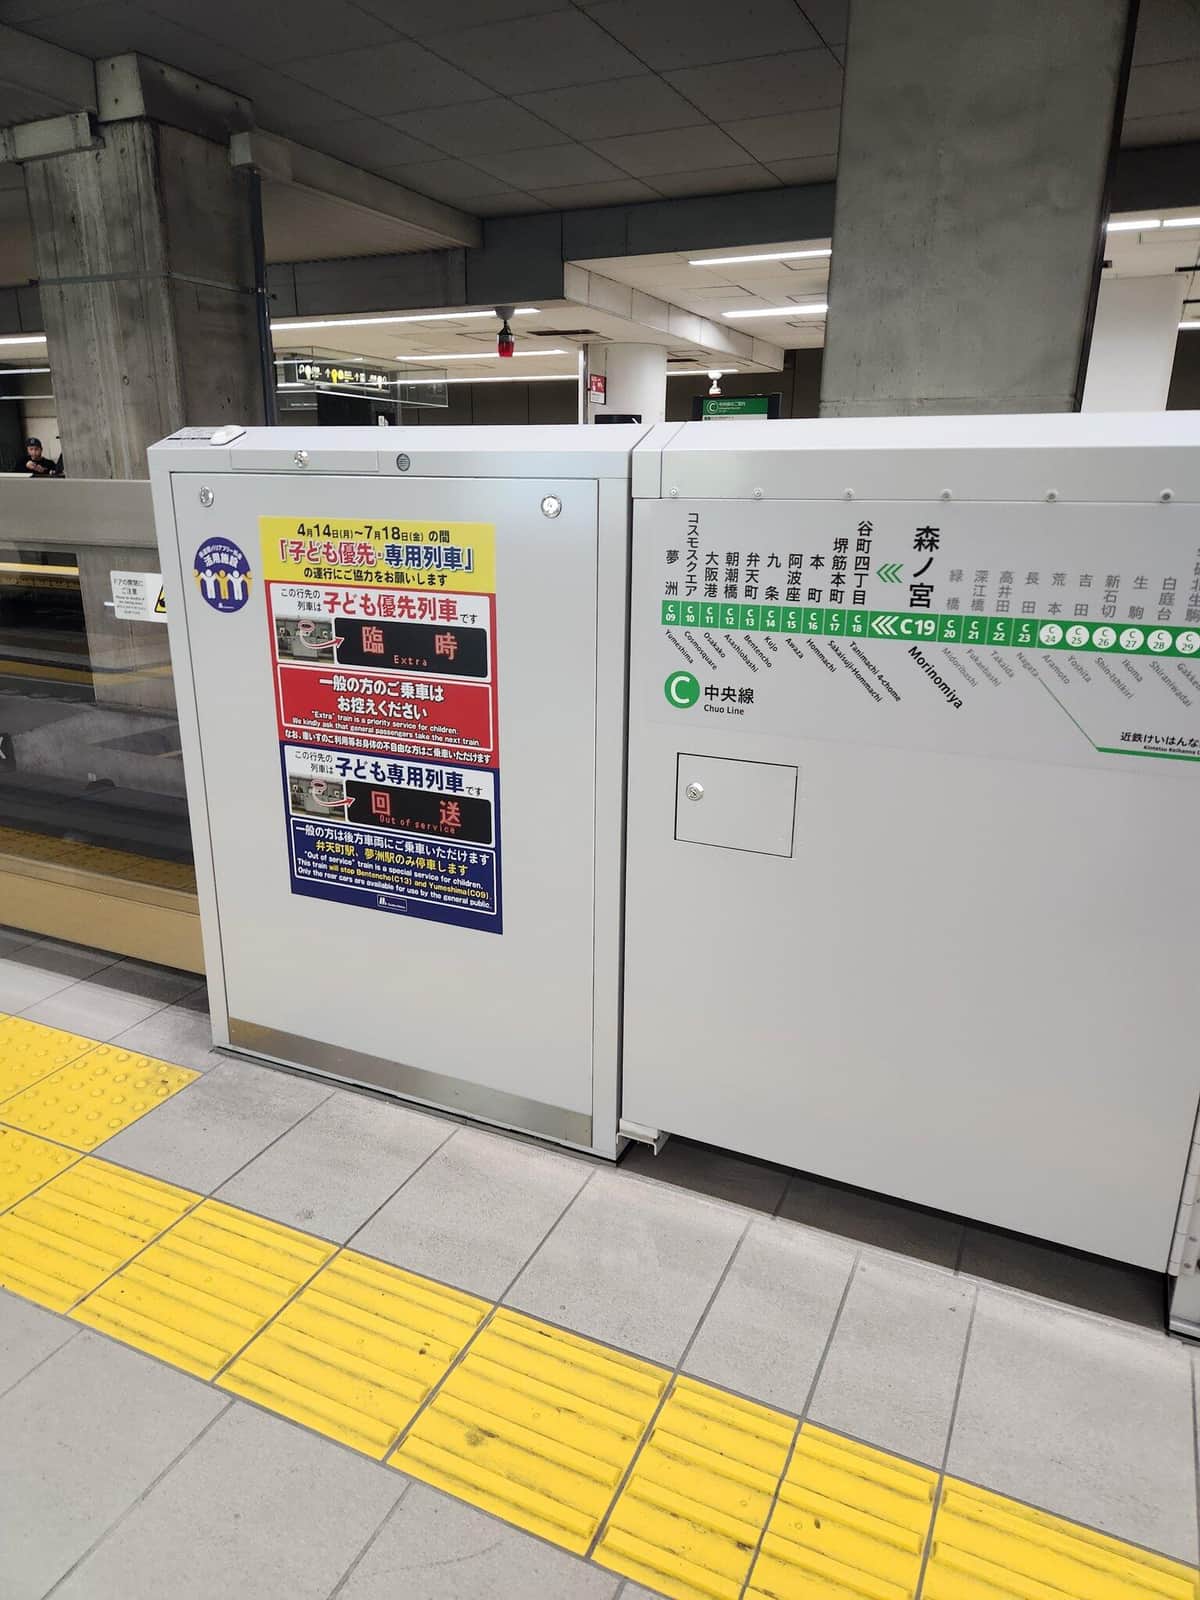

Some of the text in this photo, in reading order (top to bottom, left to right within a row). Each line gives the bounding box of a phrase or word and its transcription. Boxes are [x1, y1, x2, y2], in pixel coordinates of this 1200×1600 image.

[429, 530, 450, 543] の間
[685, 512, 699, 597] コスモスクエア
[853, 521, 873, 605] 谷町四丁目
[910, 526, 940, 609] 森ノ宮
[304, 568, 448, 586] の運行にご協力をお願いします
[665, 550, 679, 596] 夢洲
[704, 552, 719, 598] 大阪港
[724, 552, 739, 599] 朝潮橋
[744, 553, 761, 600] 弁天町
[765, 553, 782, 601] 九条
[786, 554, 803, 602] 阿波座
[808, 555, 825, 602] 本町
[829, 538, 849, 604] 堺筋本町
[281, 589, 321, 600] この行先の
[971, 570, 989, 613] 深江橋
[996, 571, 1015, 613] 高井田
[1022, 572, 1040, 615] 長田
[1048, 573, 1067, 615] 荒本
[1074, 575, 1093, 617] 吉田
[1102, 575, 1121, 618] 新石切
[1128, 577, 1149, 620] 生駒
[1157, 577, 1177, 621] 白庭台
[297, 601, 322, 613] 列車は
[666, 605, 676, 622] C 09
[686, 606, 695, 623] C 10
[705, 607, 714, 624] C 11
[725, 608, 735, 625] C 12
[745, 609, 755, 626] C 13
[766, 610, 776, 628] C 14
[787, 612, 796, 629] C 15
[808, 613, 818, 630] C 16
[830, 614, 840, 631] C 17
[852, 615, 862, 633] C 18
[900, 619, 936, 636] C19
[944, 620, 956, 639] C 20
[968, 621, 980, 640] C 21
[993, 622, 1005, 641] C 22
[1018, 624, 1031, 643] C 23
[1049, 626, 1055, 635] C
[665, 629, 695, 665] Yumeshima
[703, 632, 726, 659] Osakako
[764, 636, 779, 653] Kujo
[785, 637, 805, 660] Awaza
[1072, 628, 1083, 645] C 25
[1098, 629, 1110, 647] C 26
[1126, 631, 1138, 648] C 27
[1153, 632, 1165, 650] C 28
[1182, 633, 1194, 652] C 29
[393, 655, 428, 667] Extra
[684, 631, 718, 671] Cosmosquare
[724, 634, 760, 674] Asashiobashi
[744, 635, 773, 668] Bentencho
[806, 639, 837, 674] Hommachi
[827, 640, 882, 703] Sakaisuji-Hommachi
[850, 641, 902, 702] Tanimachi 4-chome
[942, 648, 979, 688] Midoribashi
[990, 650, 1016, 679] Takaida
[1016, 652, 1040, 678] Nagata
[1042, 655, 1071, 686] Aramoto
[1067, 655, 1093, 684] Yoshita
[1122, 659, 1143, 683] Ikoma
[320, 675, 444, 702] 一般の方のご乗車は
[670, 676, 690, 704] C
[908, 646, 964, 710] Morinomiya
[1095, 657, 1134, 700] Shin-Ishikiri
[1149, 661, 1193, 708] Shiraniwadai
[704, 684, 755, 705] 中央線
[338, 696, 428, 720] お控えください
[704, 705, 745, 716] Chuo Line
[338, 714, 353, 722] train
[367, 718, 391, 727] priority
[393, 722, 416, 730] service
[415, 732, 430, 740] take
[432, 734, 443, 742] the
[445, 736, 461, 744] next
[1120, 732, 1200, 748] 近鉄けいはんな
[295, 751, 333, 762] この行先の
[311, 764, 334, 775] 列車は
[379, 814, 456, 835] Out of service
[296, 825, 490, 866] 一般の方は後方車両にご乗車いただけます
[297, 858, 311, 867] This
[313, 861, 328, 869] train
[341, 866, 355, 875] stop
[414, 880, 427, 888] and
[298, 866, 312, 876] Only
[313, 869, 324, 877] the
[367, 880, 395, 890] available
[396, 884, 406, 892] for
[420, 889, 429, 898] by
[430, 891, 442, 899] the
[358, 861, 374, 870] train
[375, 863, 381, 871] is
[389, 866, 412, 876] special
[414, 871, 439, 881] service
[441, 875, 452, 883] for
